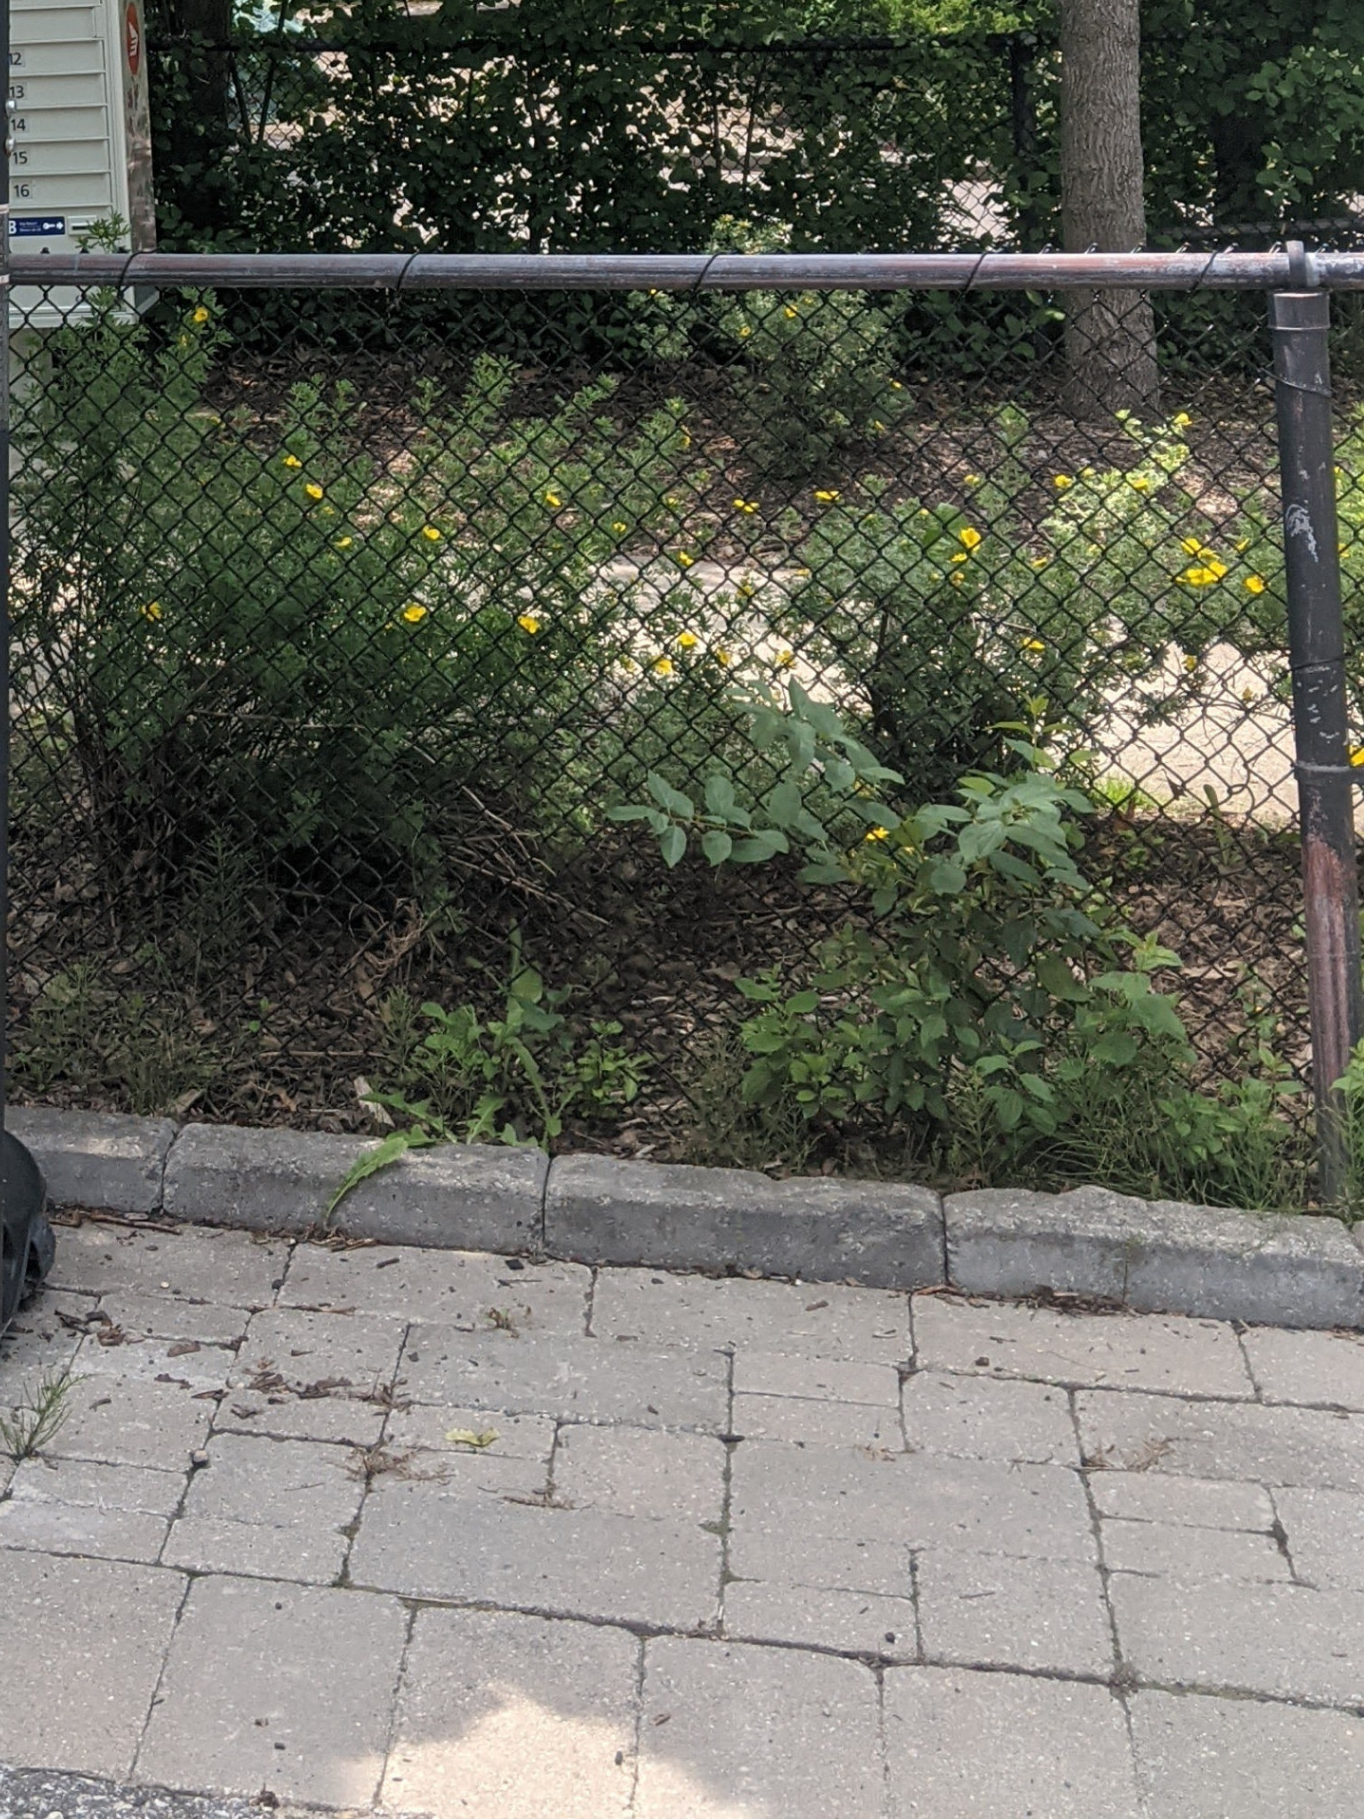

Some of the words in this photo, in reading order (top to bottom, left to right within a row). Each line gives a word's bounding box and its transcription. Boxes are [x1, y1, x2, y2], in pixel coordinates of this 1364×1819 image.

[9, 85, 25, 99] 13
[11, 118, 26, 131] 14
[12, 151, 28, 165] 15
[14, 184, 30, 198] 16
[8, 220, 17, 234] B
